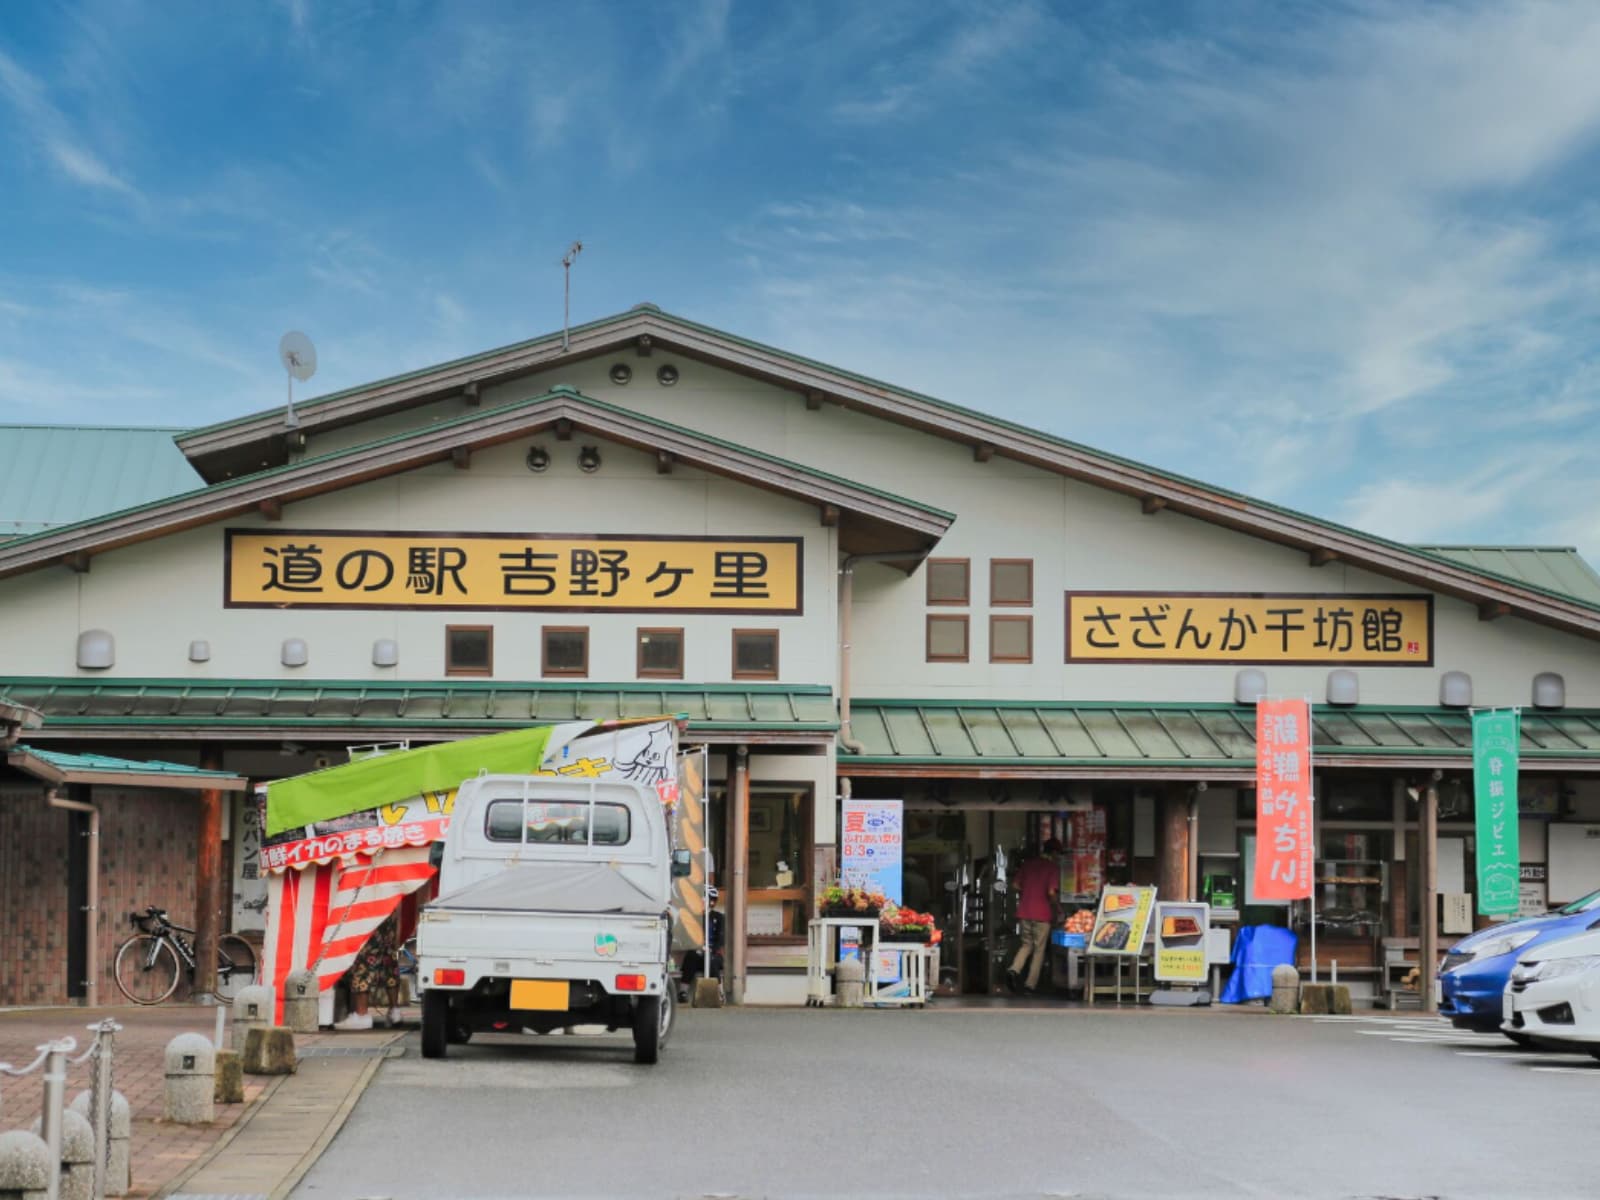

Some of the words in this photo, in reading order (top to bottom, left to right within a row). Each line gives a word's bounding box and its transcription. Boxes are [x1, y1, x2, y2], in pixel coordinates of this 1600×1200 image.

[262, 543, 468, 596] 道の駅
[498, 546, 770, 599] 吉野ヶ里
[1083, 603, 1403, 653] さざんか千坊館
[242, 795, 260, 880] のパン屋
[844, 811, 866, 833] 夏
[844, 844, 866, 857] 8/3
